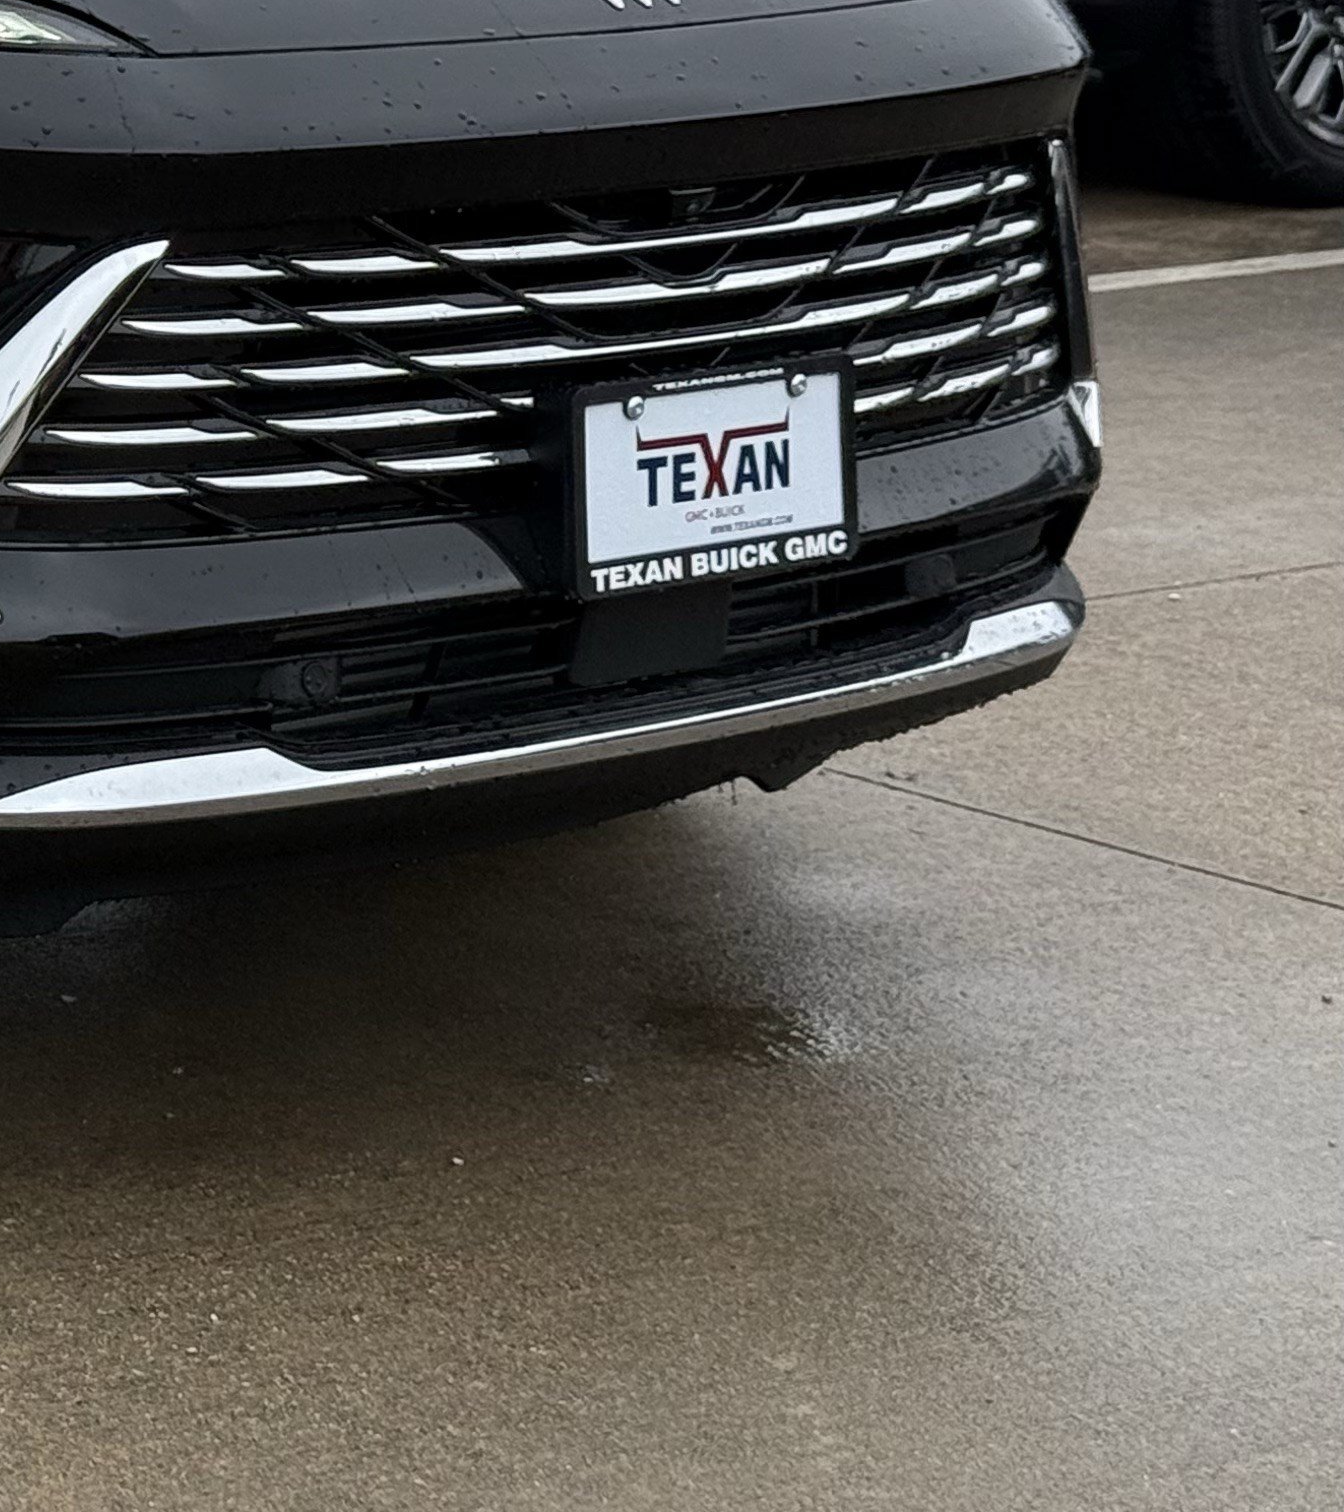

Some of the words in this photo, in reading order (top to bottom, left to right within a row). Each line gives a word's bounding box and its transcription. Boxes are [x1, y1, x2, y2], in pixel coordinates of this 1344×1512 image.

[636, 429, 790, 507] TEXAN
[590, 555, 684, 593] TEXAN
[691, 541, 779, 578] BUICK
[784, 530, 848, 562] GMC
